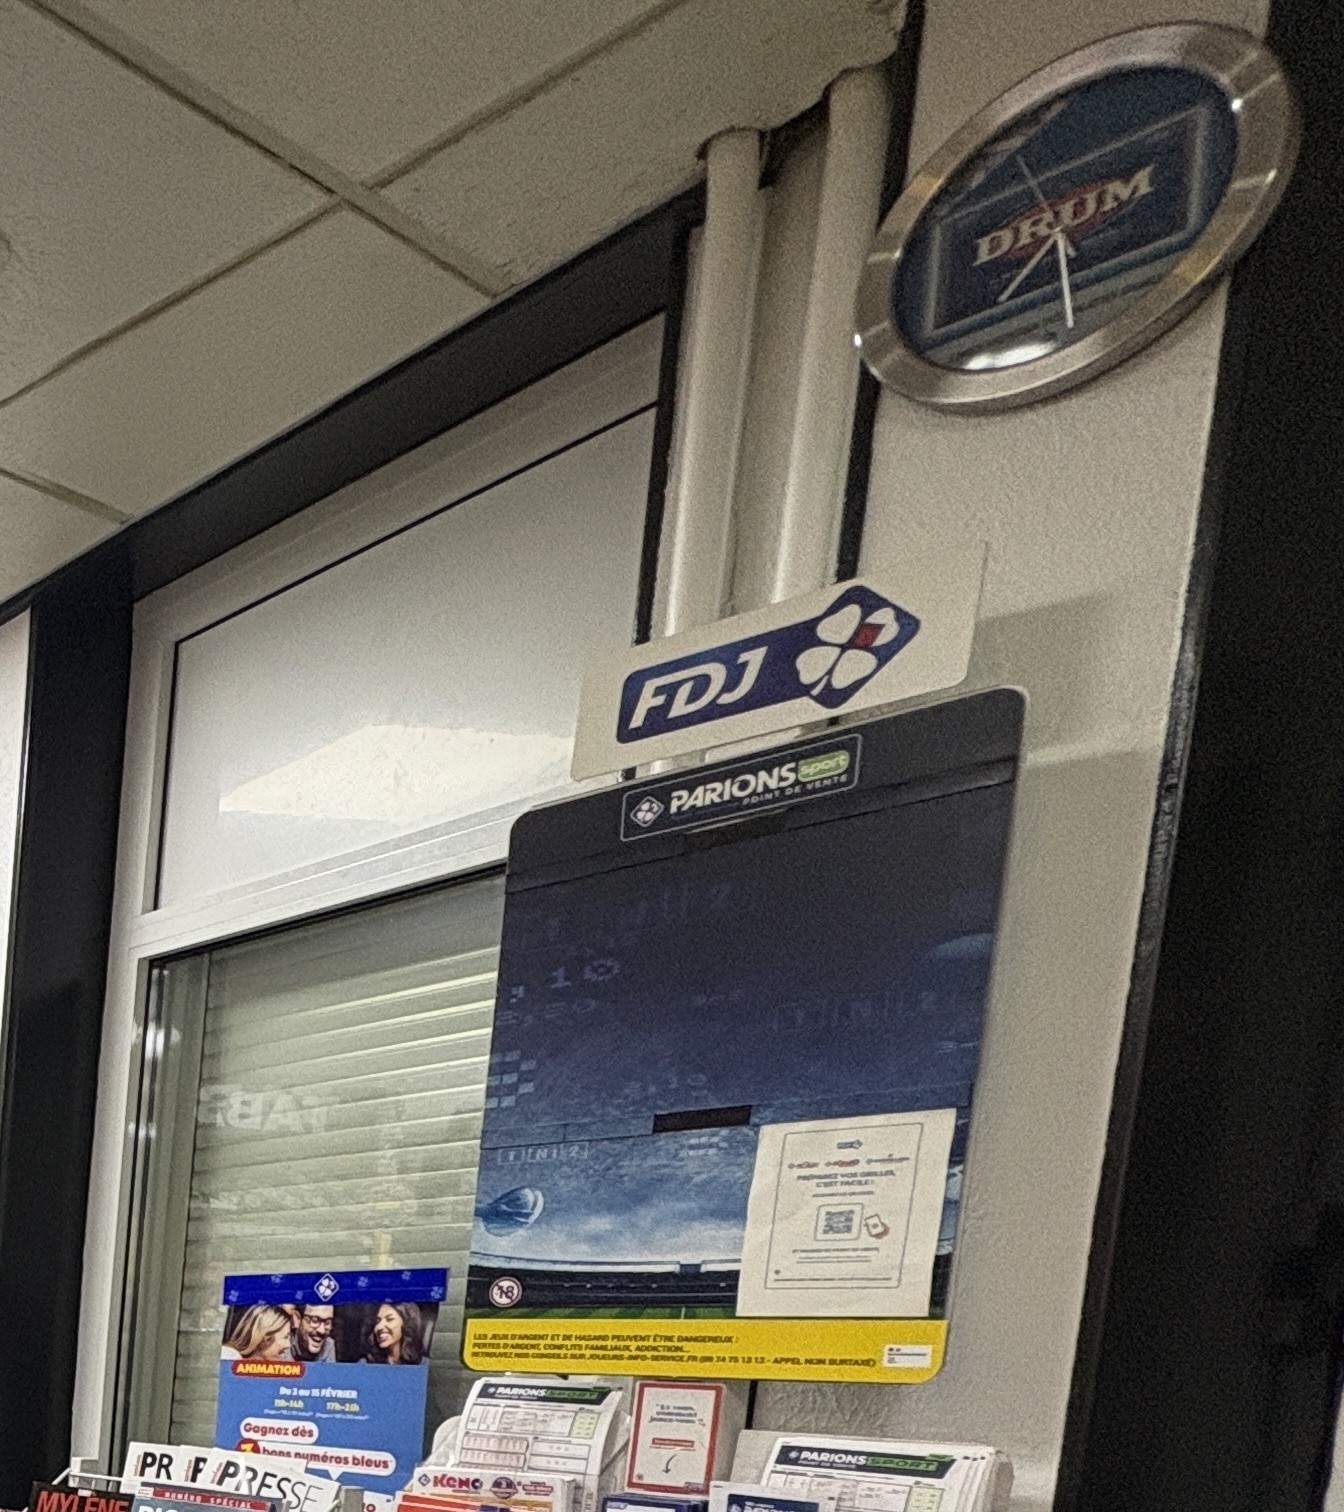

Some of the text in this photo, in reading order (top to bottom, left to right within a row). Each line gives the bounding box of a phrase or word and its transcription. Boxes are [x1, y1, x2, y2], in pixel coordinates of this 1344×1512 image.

[973, 160, 1157, 266] DRUM
[628, 646, 768, 730] FDJ
[670, 751, 848, 814] PARIONS sport
[236, 1363, 301, 1376] ANIMATION
[321, 1387, 358, 1399] FÉVRIER
[497, 1386, 547, 1398] PARIONS
[243, 1423, 314, 1438] Gagnez dès
[294, 1452, 349, 1466] numéros
[351, 1454, 390, 1470] bleus
[801, 1450, 936, 1471] PARIONS SPORT
[210, 1496, 252, 1509] SPÉCIAL
